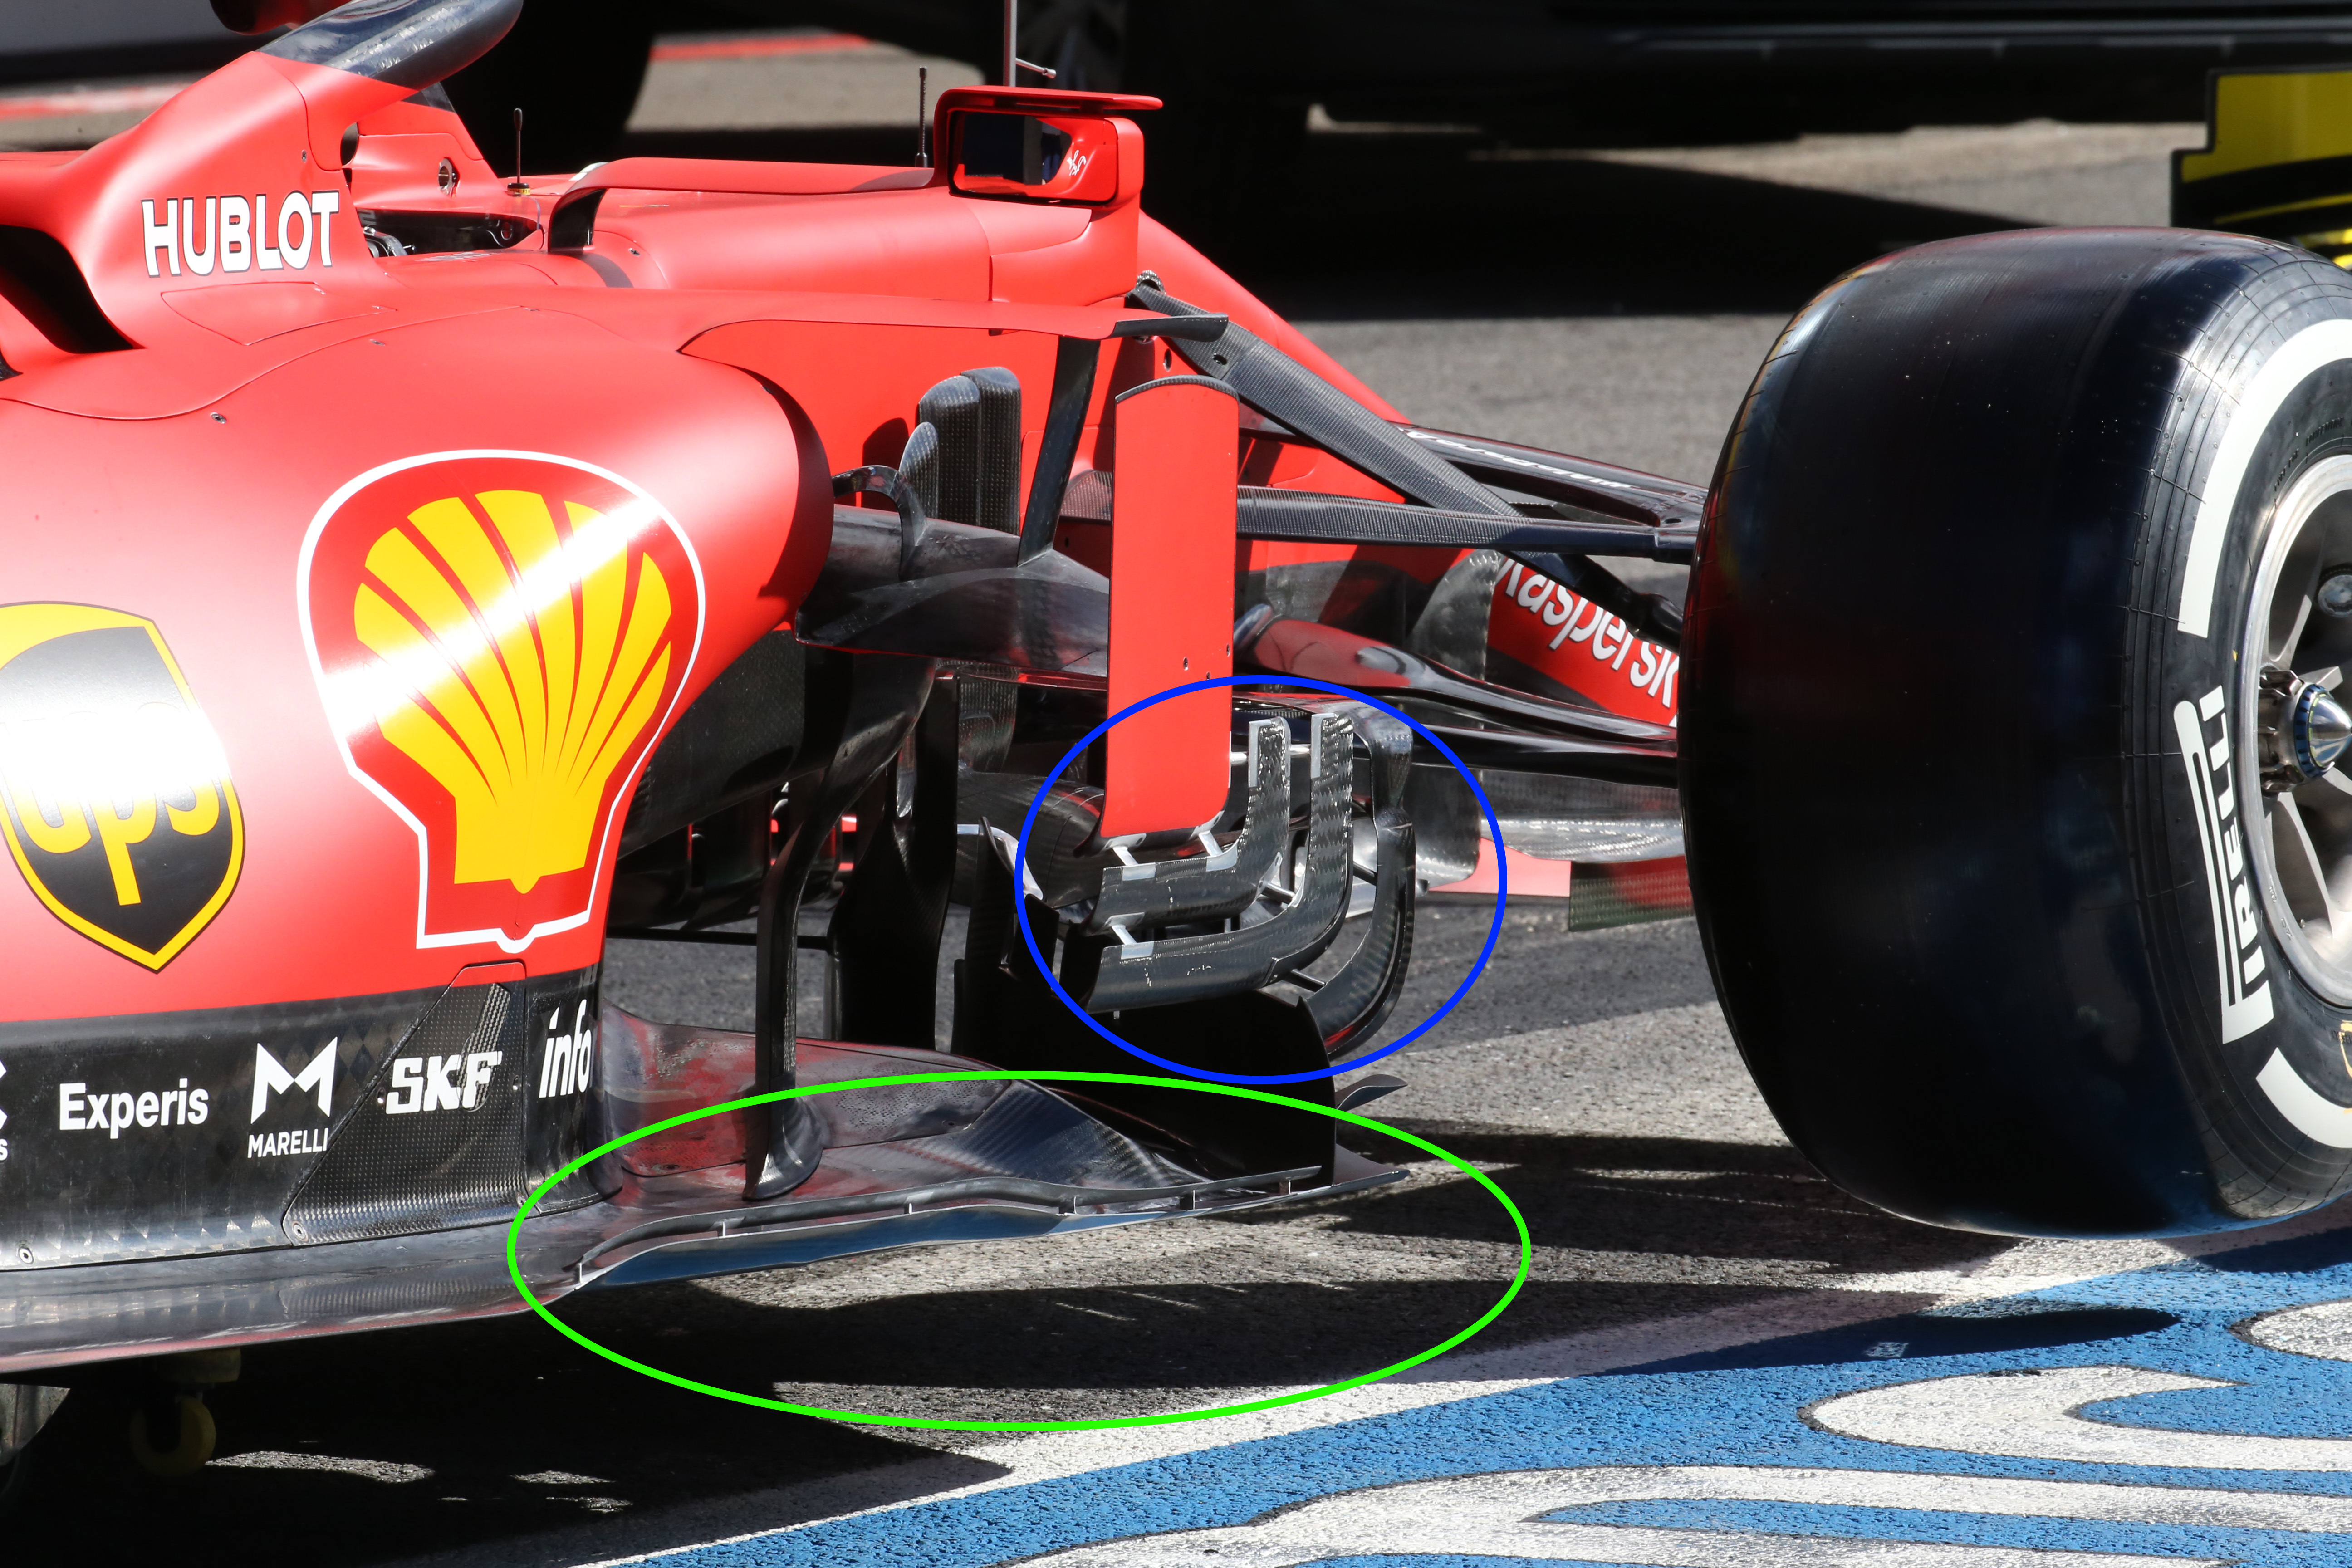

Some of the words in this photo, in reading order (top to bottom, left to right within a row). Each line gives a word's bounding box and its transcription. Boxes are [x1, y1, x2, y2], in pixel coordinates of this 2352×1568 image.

[141, 190, 339, 277] HUBLOT
[2173, 685, 2274, 1044] PIRELLI
[386, 1051, 502, 1114] SKF
[539, 999, 597, 1098] info
[59, 1078, 209, 1139] Experis
[247, 1128, 329, 1158] MARELLI
